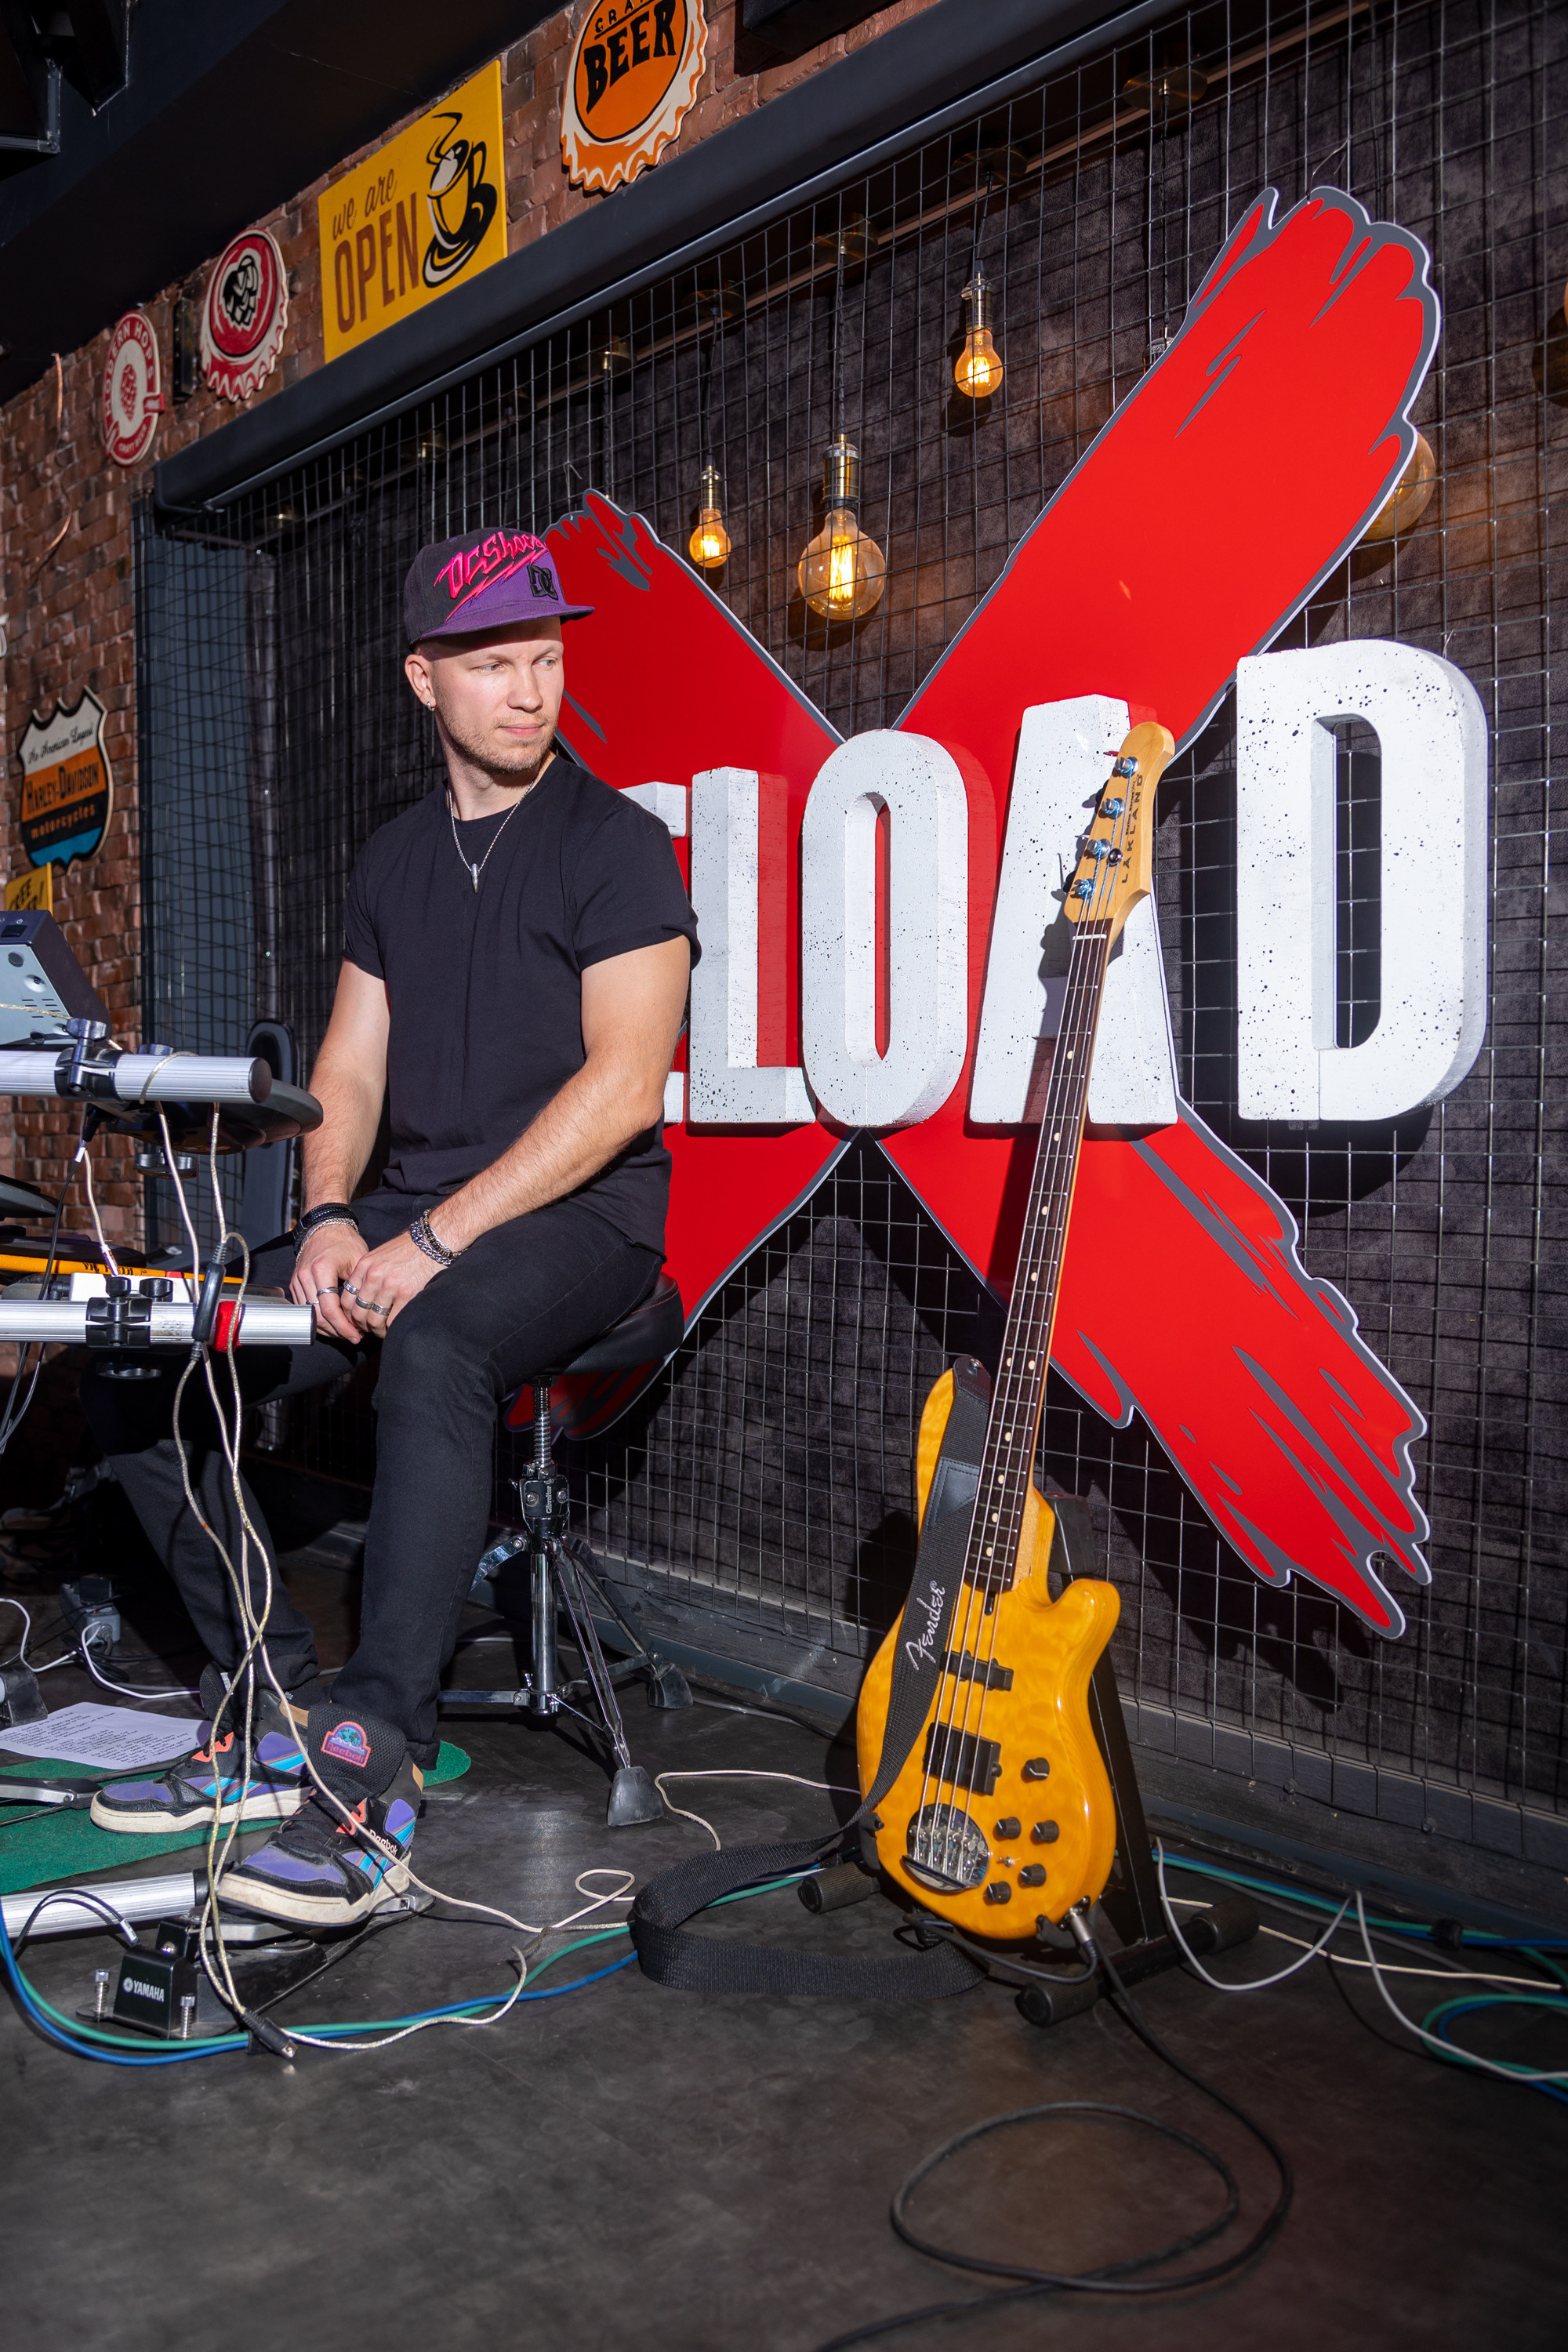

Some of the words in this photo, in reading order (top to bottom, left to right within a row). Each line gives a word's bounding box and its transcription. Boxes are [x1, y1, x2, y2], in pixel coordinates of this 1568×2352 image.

[595, 0, 644, 33] CRA
[584, 0, 677, 114] BEER
[332, 203, 357, 241] we
[365, 169, 397, 218] are
[335, 192, 419, 333] OPEN
[134, 320, 154, 379] HOPS
[31, 804, 96, 840] motorcycles
[618, 638, 1487, 1127] LOAD
[104, 1265, 133, 1276] FTH
[906, 1585, 946, 1671] Fender
[327, 1742, 365, 1762] Reebok
[132, 1980, 165, 2002] YAMAHA
